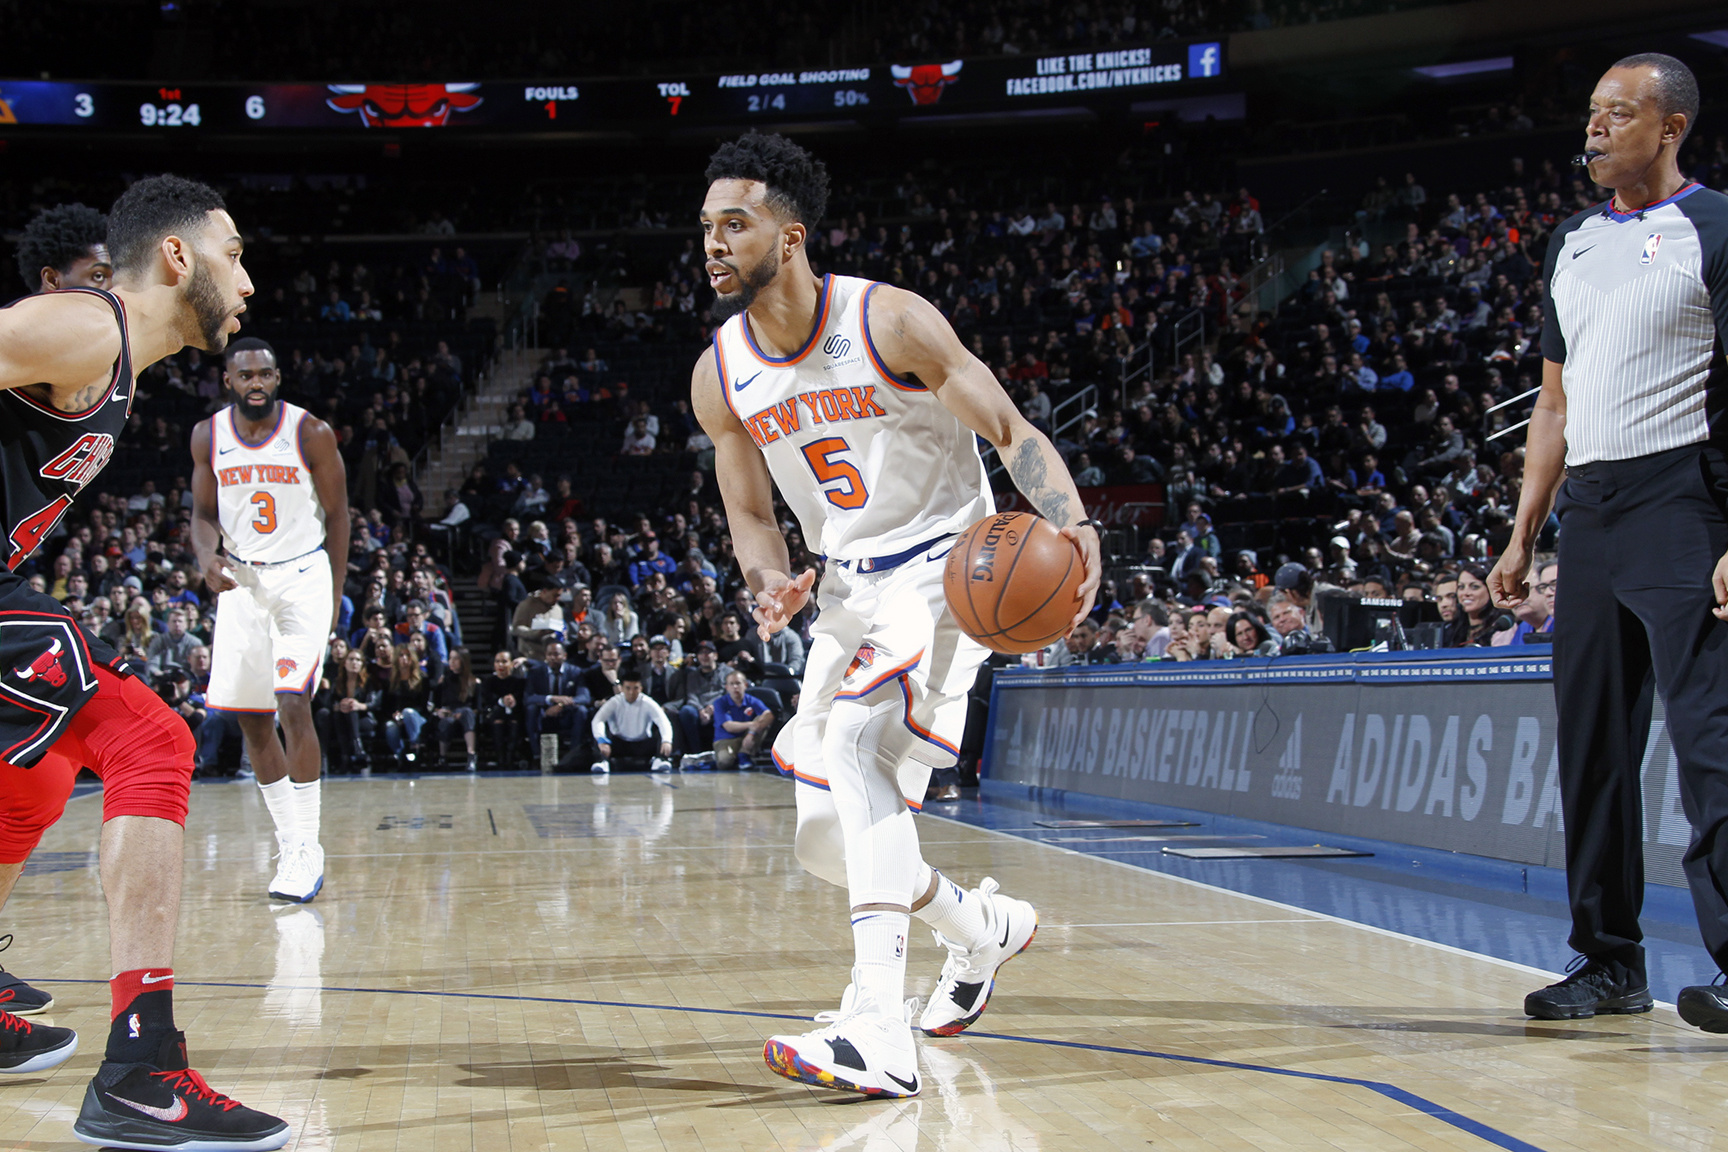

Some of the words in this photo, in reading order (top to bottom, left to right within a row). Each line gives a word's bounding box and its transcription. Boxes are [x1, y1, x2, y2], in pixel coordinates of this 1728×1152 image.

[1036, 57, 1066, 76] LIKE
[1068, 53, 1094, 73] THE
[1096, 48, 1152, 70] KNICKS!
[657, 82, 690, 96] TOL
[718, 73, 757, 88] FIELD
[758, 71, 796, 86] GOAL
[799, 68, 870, 84] SHOOTING
[1006, 64, 1183, 96] FACEBOOK.COM/NYKNICKS
[74, 93, 95, 117] 3
[158, 87, 182, 101] 1st
[525, 86, 579, 101] FOULS
[833, 90, 870, 107] 50%
[139, 103, 201, 127] 9:24
[244, 96, 266, 120] 6
[544, 101, 557, 119] 1
[668, 97, 682, 116] 7
[822, 356, 861, 371] SQUARESPACE
[743, 397, 801, 449] NEW
[799, 385, 888, 425] YORK
[218, 465, 252, 488] NEW
[252, 464, 300, 485] YORK
[800, 437, 869, 511] 5
[250, 490, 277, 534] 3
[1360, 597, 1404, 608] SAMSUNG
[1031, 707, 1103, 774] ADIDAS
[1102, 708, 1255, 793] BASKETBALL
[1326, 712, 1494, 822] ADIDAS
